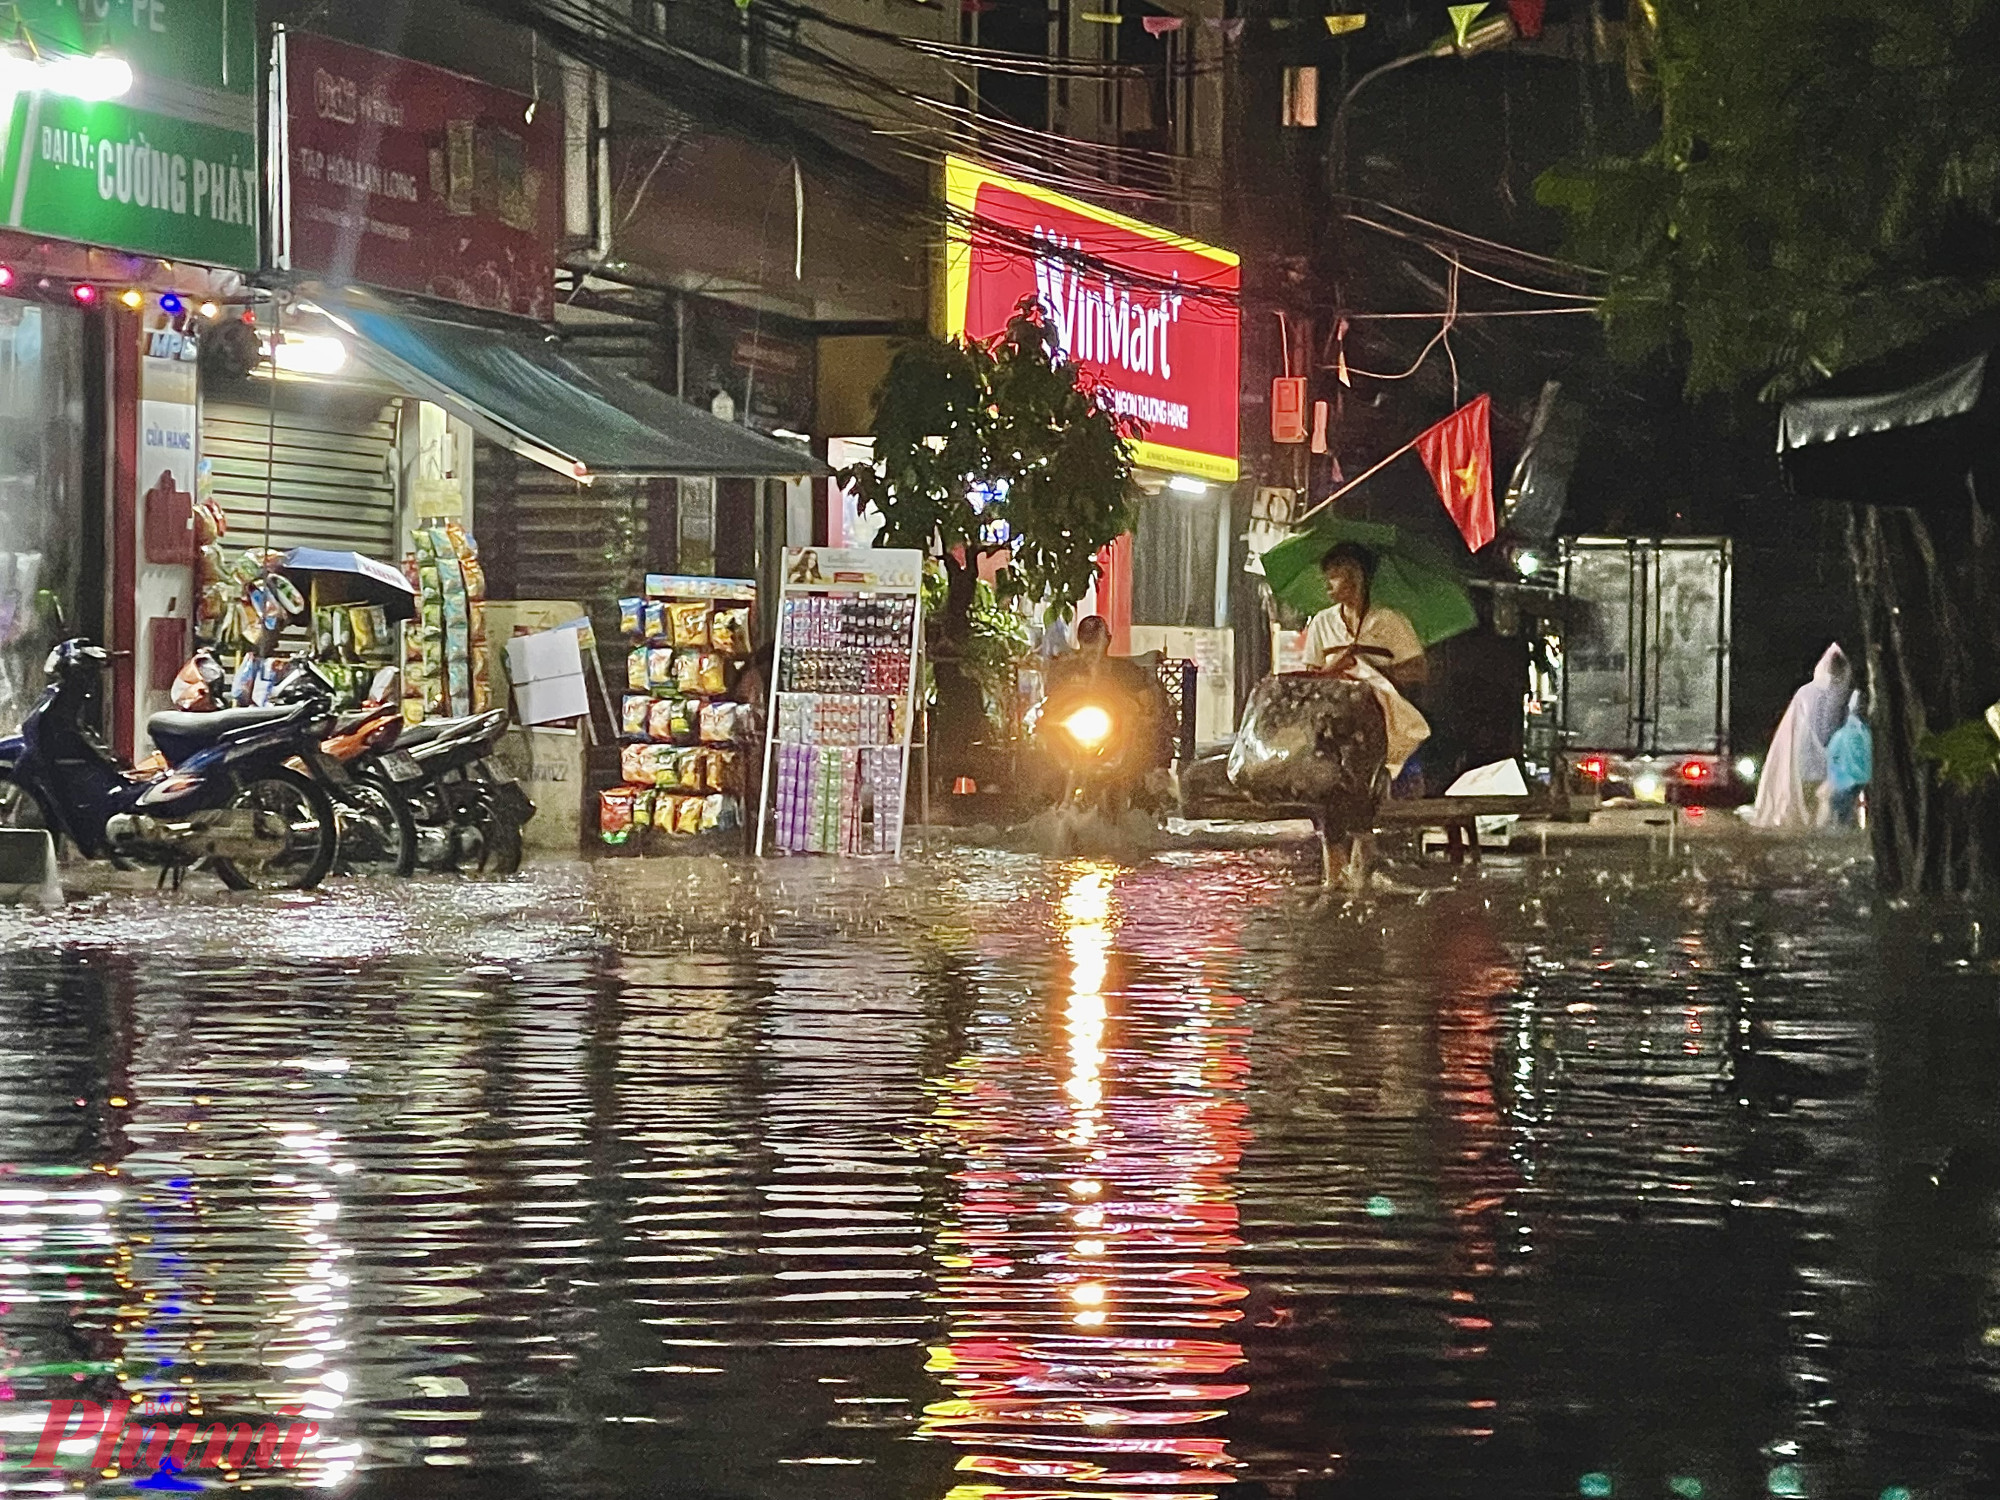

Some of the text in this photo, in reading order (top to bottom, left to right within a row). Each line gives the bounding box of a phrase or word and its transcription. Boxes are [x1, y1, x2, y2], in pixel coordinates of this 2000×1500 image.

[41, 126, 68, 170] ĐẠI
[72, 126, 94, 170] LÝ:
[97, 132, 187, 214] CƯỜNG
[193, 154, 256, 226] PHÁT
